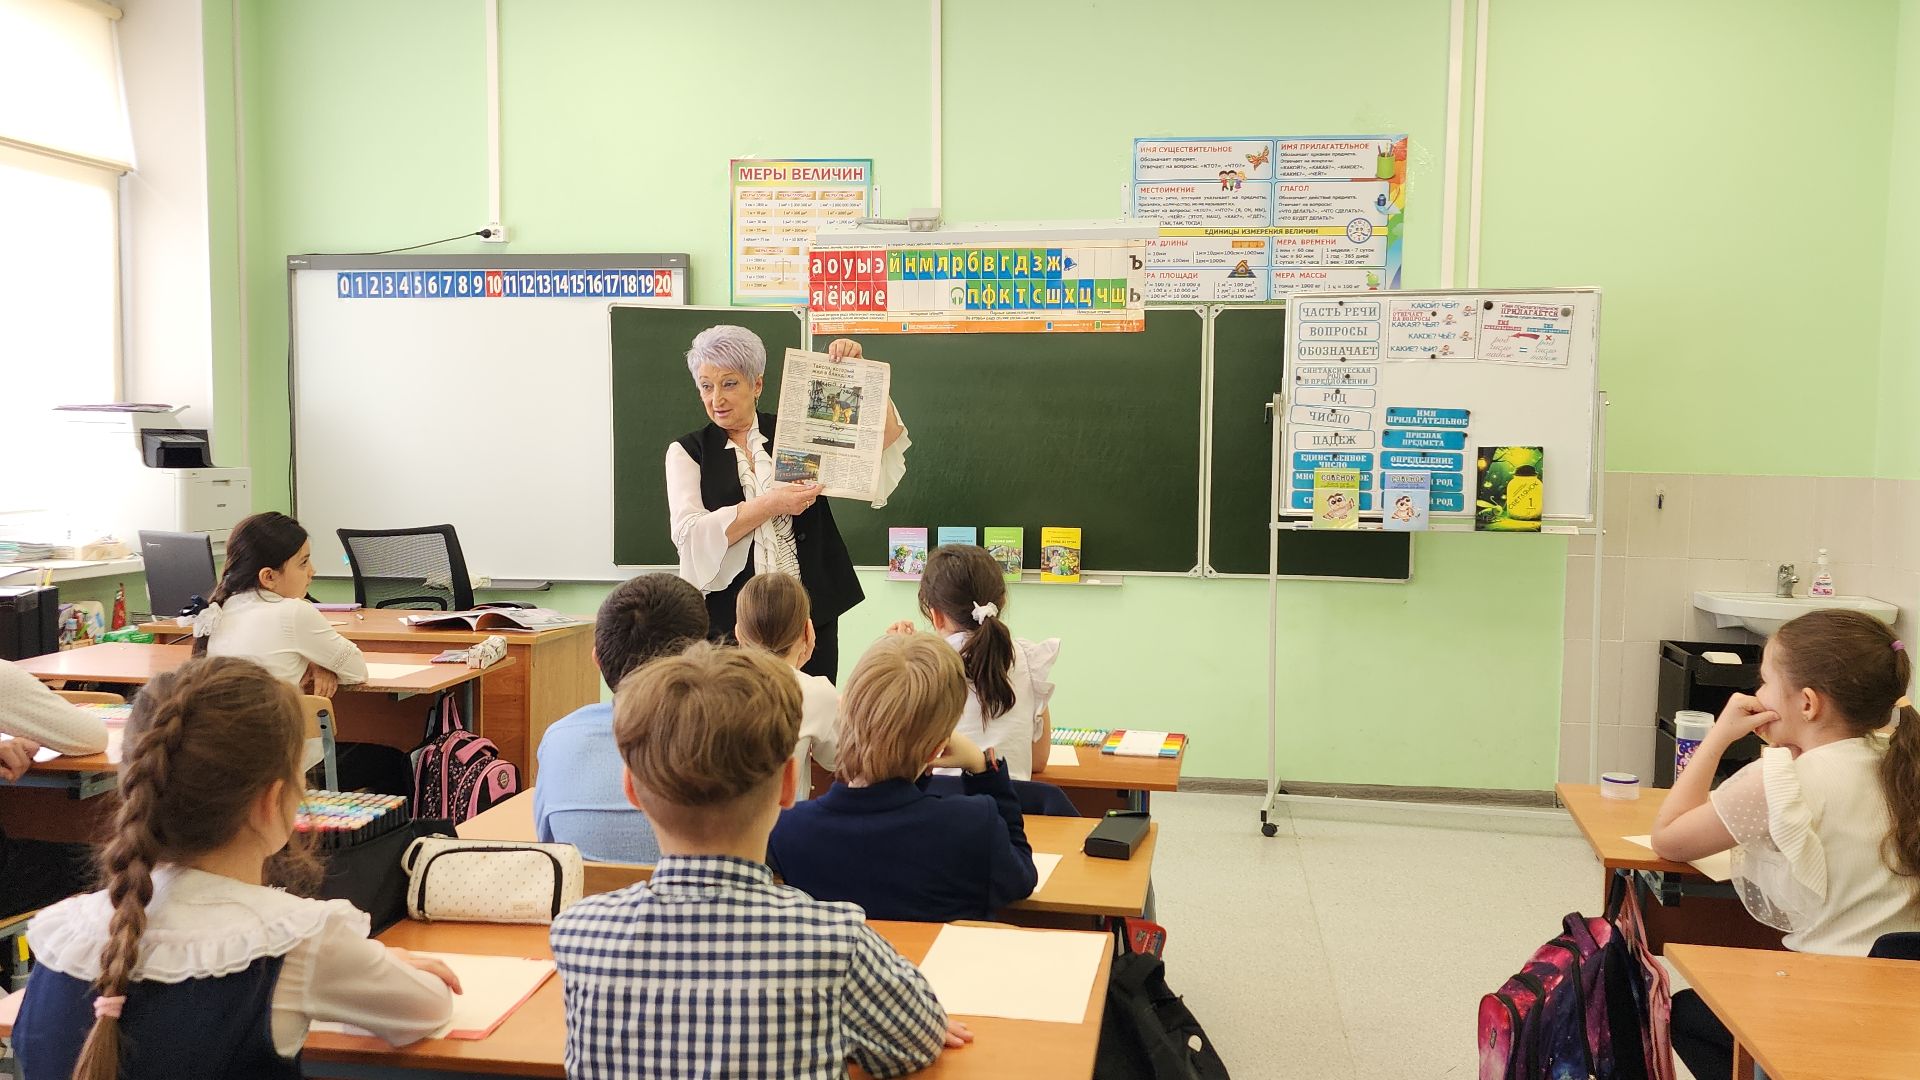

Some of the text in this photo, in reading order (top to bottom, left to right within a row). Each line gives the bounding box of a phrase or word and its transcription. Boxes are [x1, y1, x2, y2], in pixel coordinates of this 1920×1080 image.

[740, 168, 863, 180] МЕРЫ ВЕЛИЧИН
[812, 251, 1060, 279] а о у ы э й н м л р б в г д з ж
[1130, 255, 1143, 270] ъ
[341, 274, 671, 294] 0 1 2 3 4 5 6 7 8 9 10 11 12 13 14 15 16 17 18 19 20
[813, 284, 1125, 309] я ё ю и е п ф к т с ш х ц ч щ
[1303, 307, 1376, 316] ЧАСТЬ РЕЧИ
[1501, 308, 1558, 317] ПРИЛАГАЕТСЯ
[1309, 327, 1368, 336] ВОПРОСЫ
[1300, 346, 1378, 355] ОБОЗНАЧАЕТ
[1323, 393, 1346, 404] РОД
[1310, 412, 1350, 424] ЧИСЛО
[1387, 416, 1468, 425] ПРИЛАГАТЕЛЬНОЕ
[1313, 436, 1356, 446] ПАДЕЖ
[1301, 454, 1366, 462] ЕДИНСТВЕННОЕ
[1391, 456, 1453, 464] ОПРЕДЕЛЕНИЕ
